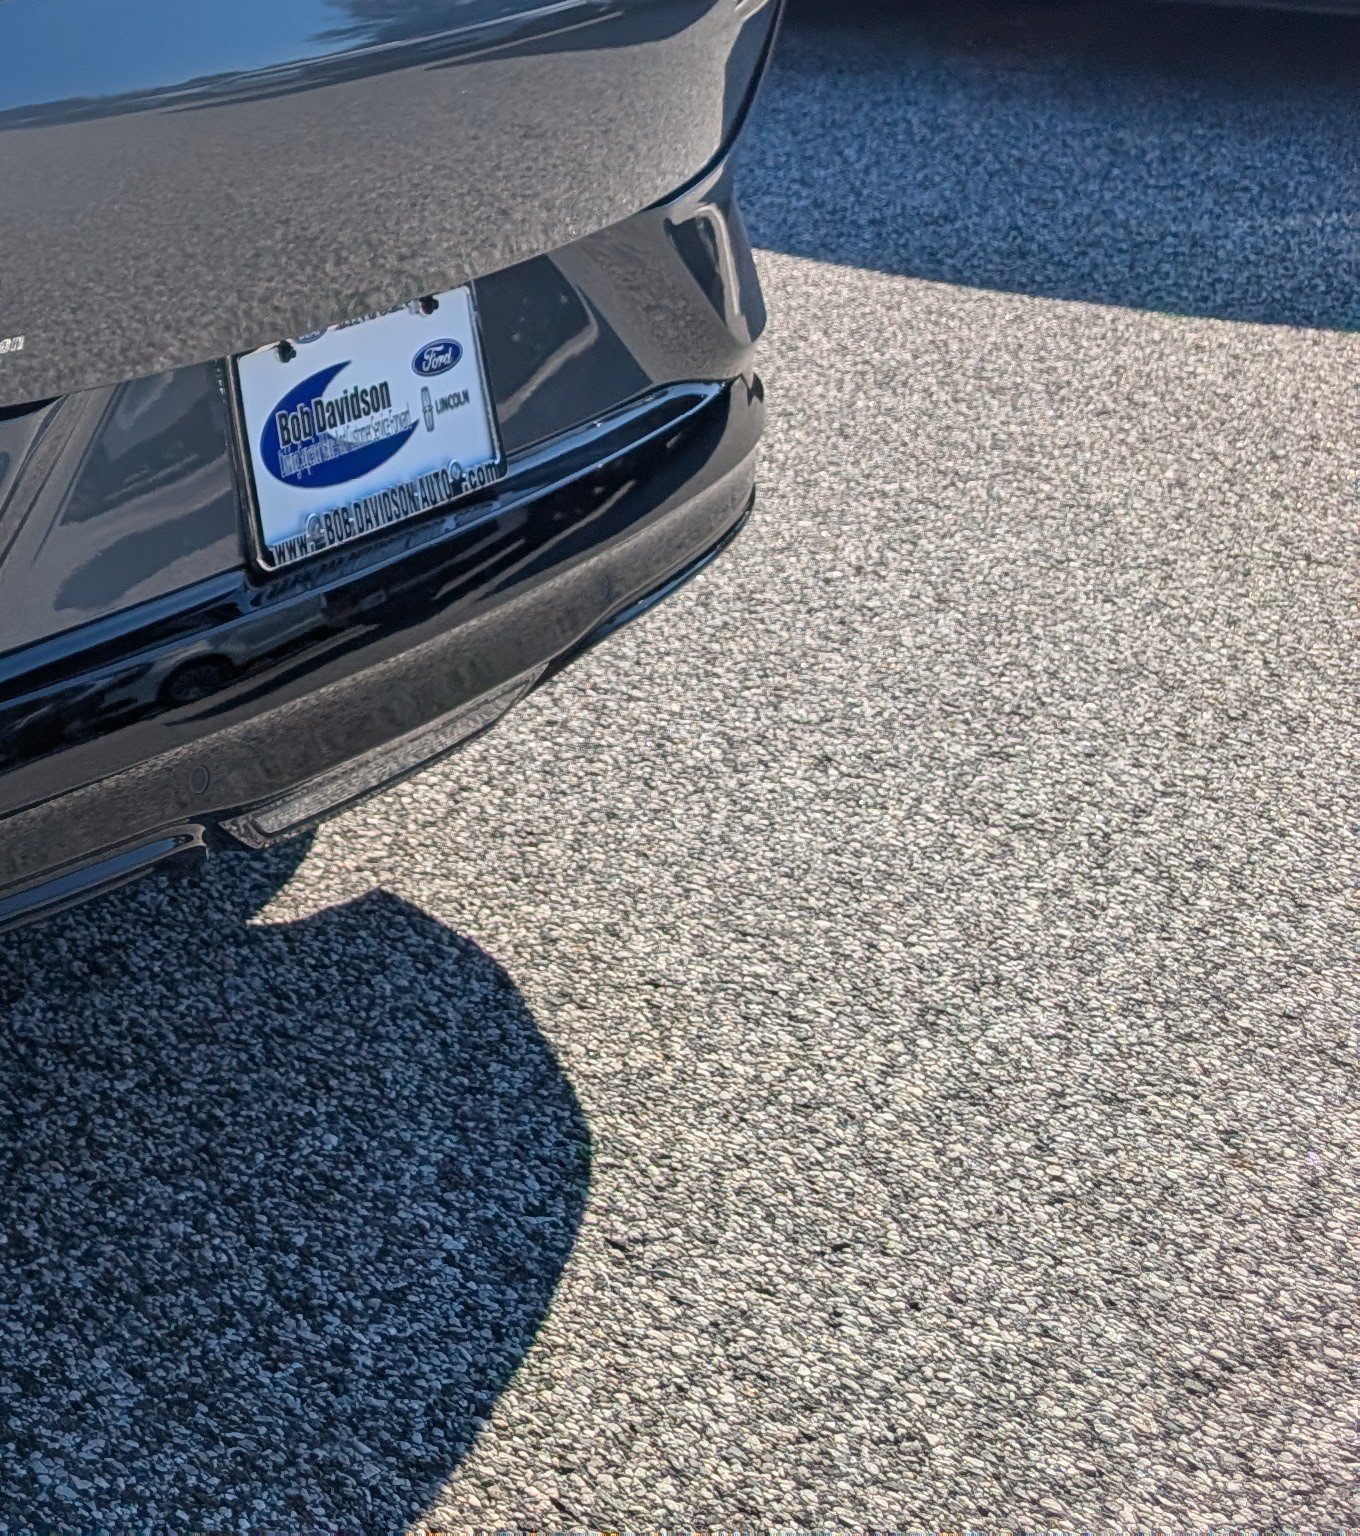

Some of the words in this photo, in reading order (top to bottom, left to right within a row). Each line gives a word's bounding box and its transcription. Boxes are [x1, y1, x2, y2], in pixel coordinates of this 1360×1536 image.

[420, 343, 455, 373] Ford
[277, 402, 315, 447] Bob
[314, 380, 392, 434] Davidson
[434, 389, 470, 415] LINCOLN
